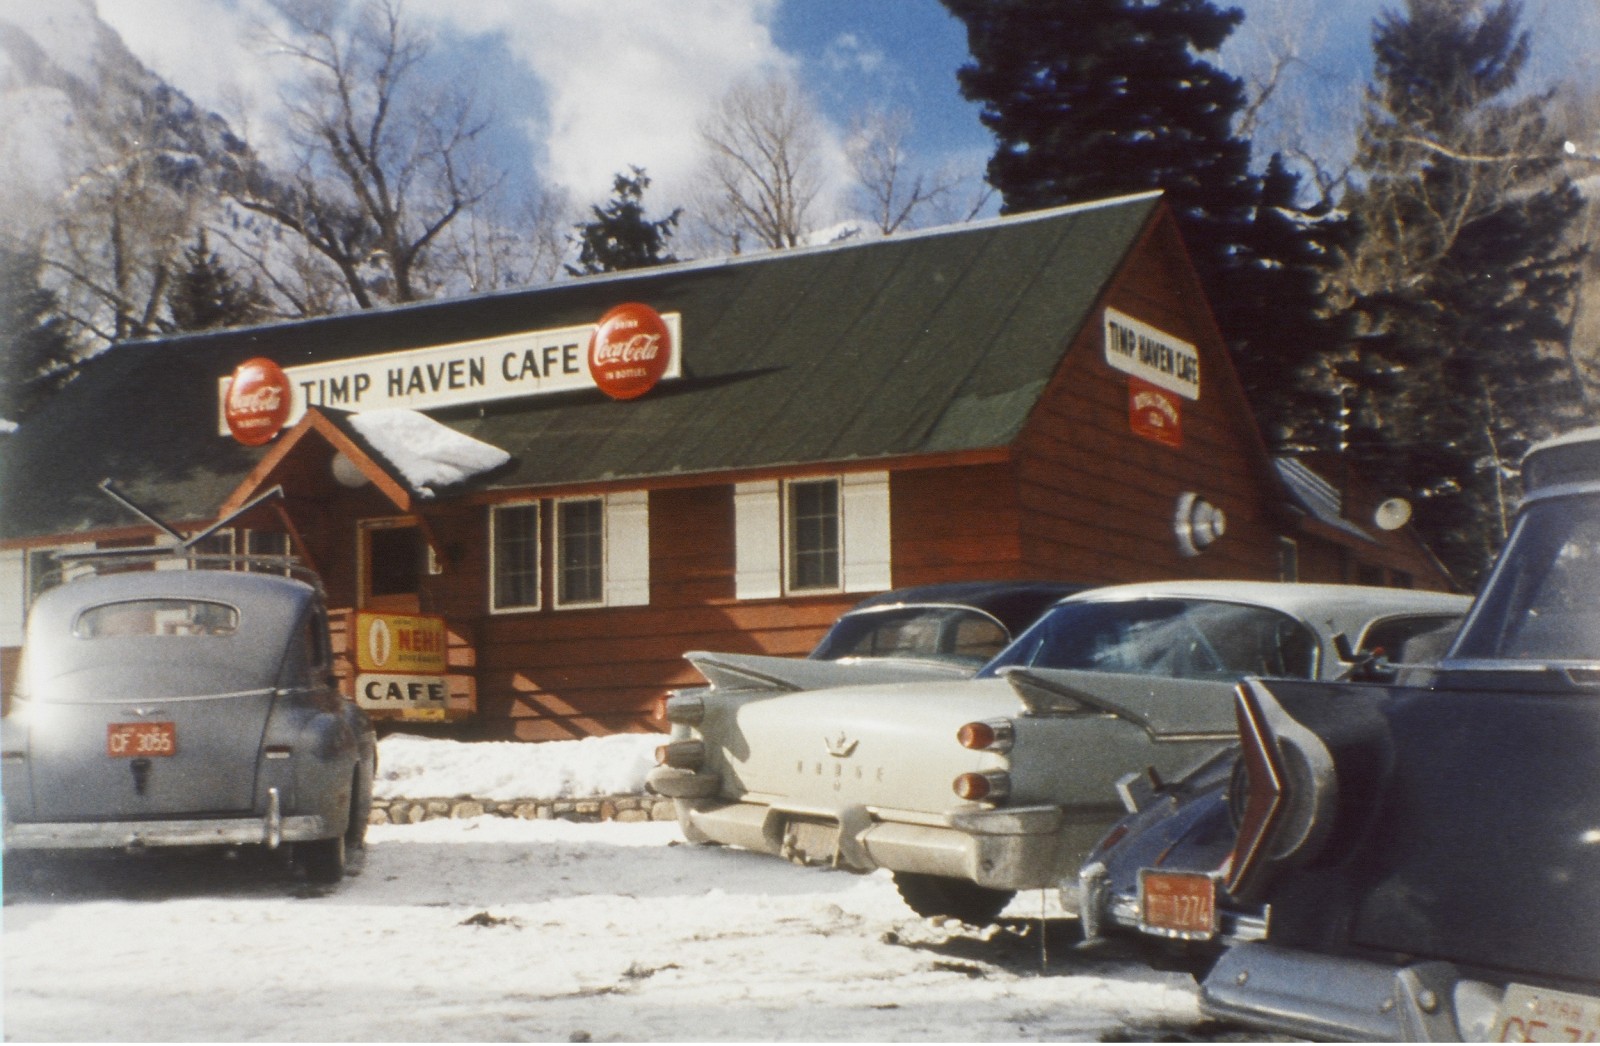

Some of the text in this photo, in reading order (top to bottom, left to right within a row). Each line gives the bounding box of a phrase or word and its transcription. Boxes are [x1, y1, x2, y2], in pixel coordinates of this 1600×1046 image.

[1109, 321, 1197, 384] TIMP HAVEN CAFE
[300, 373, 370, 405] TIMP
[388, 357, 485, 397] HAVEN
[503, 344, 579, 381] CAFE
[399, 629, 440, 652] NEHI
[365, 681, 444, 700] CAFE
[111, 733, 131, 752] CF
